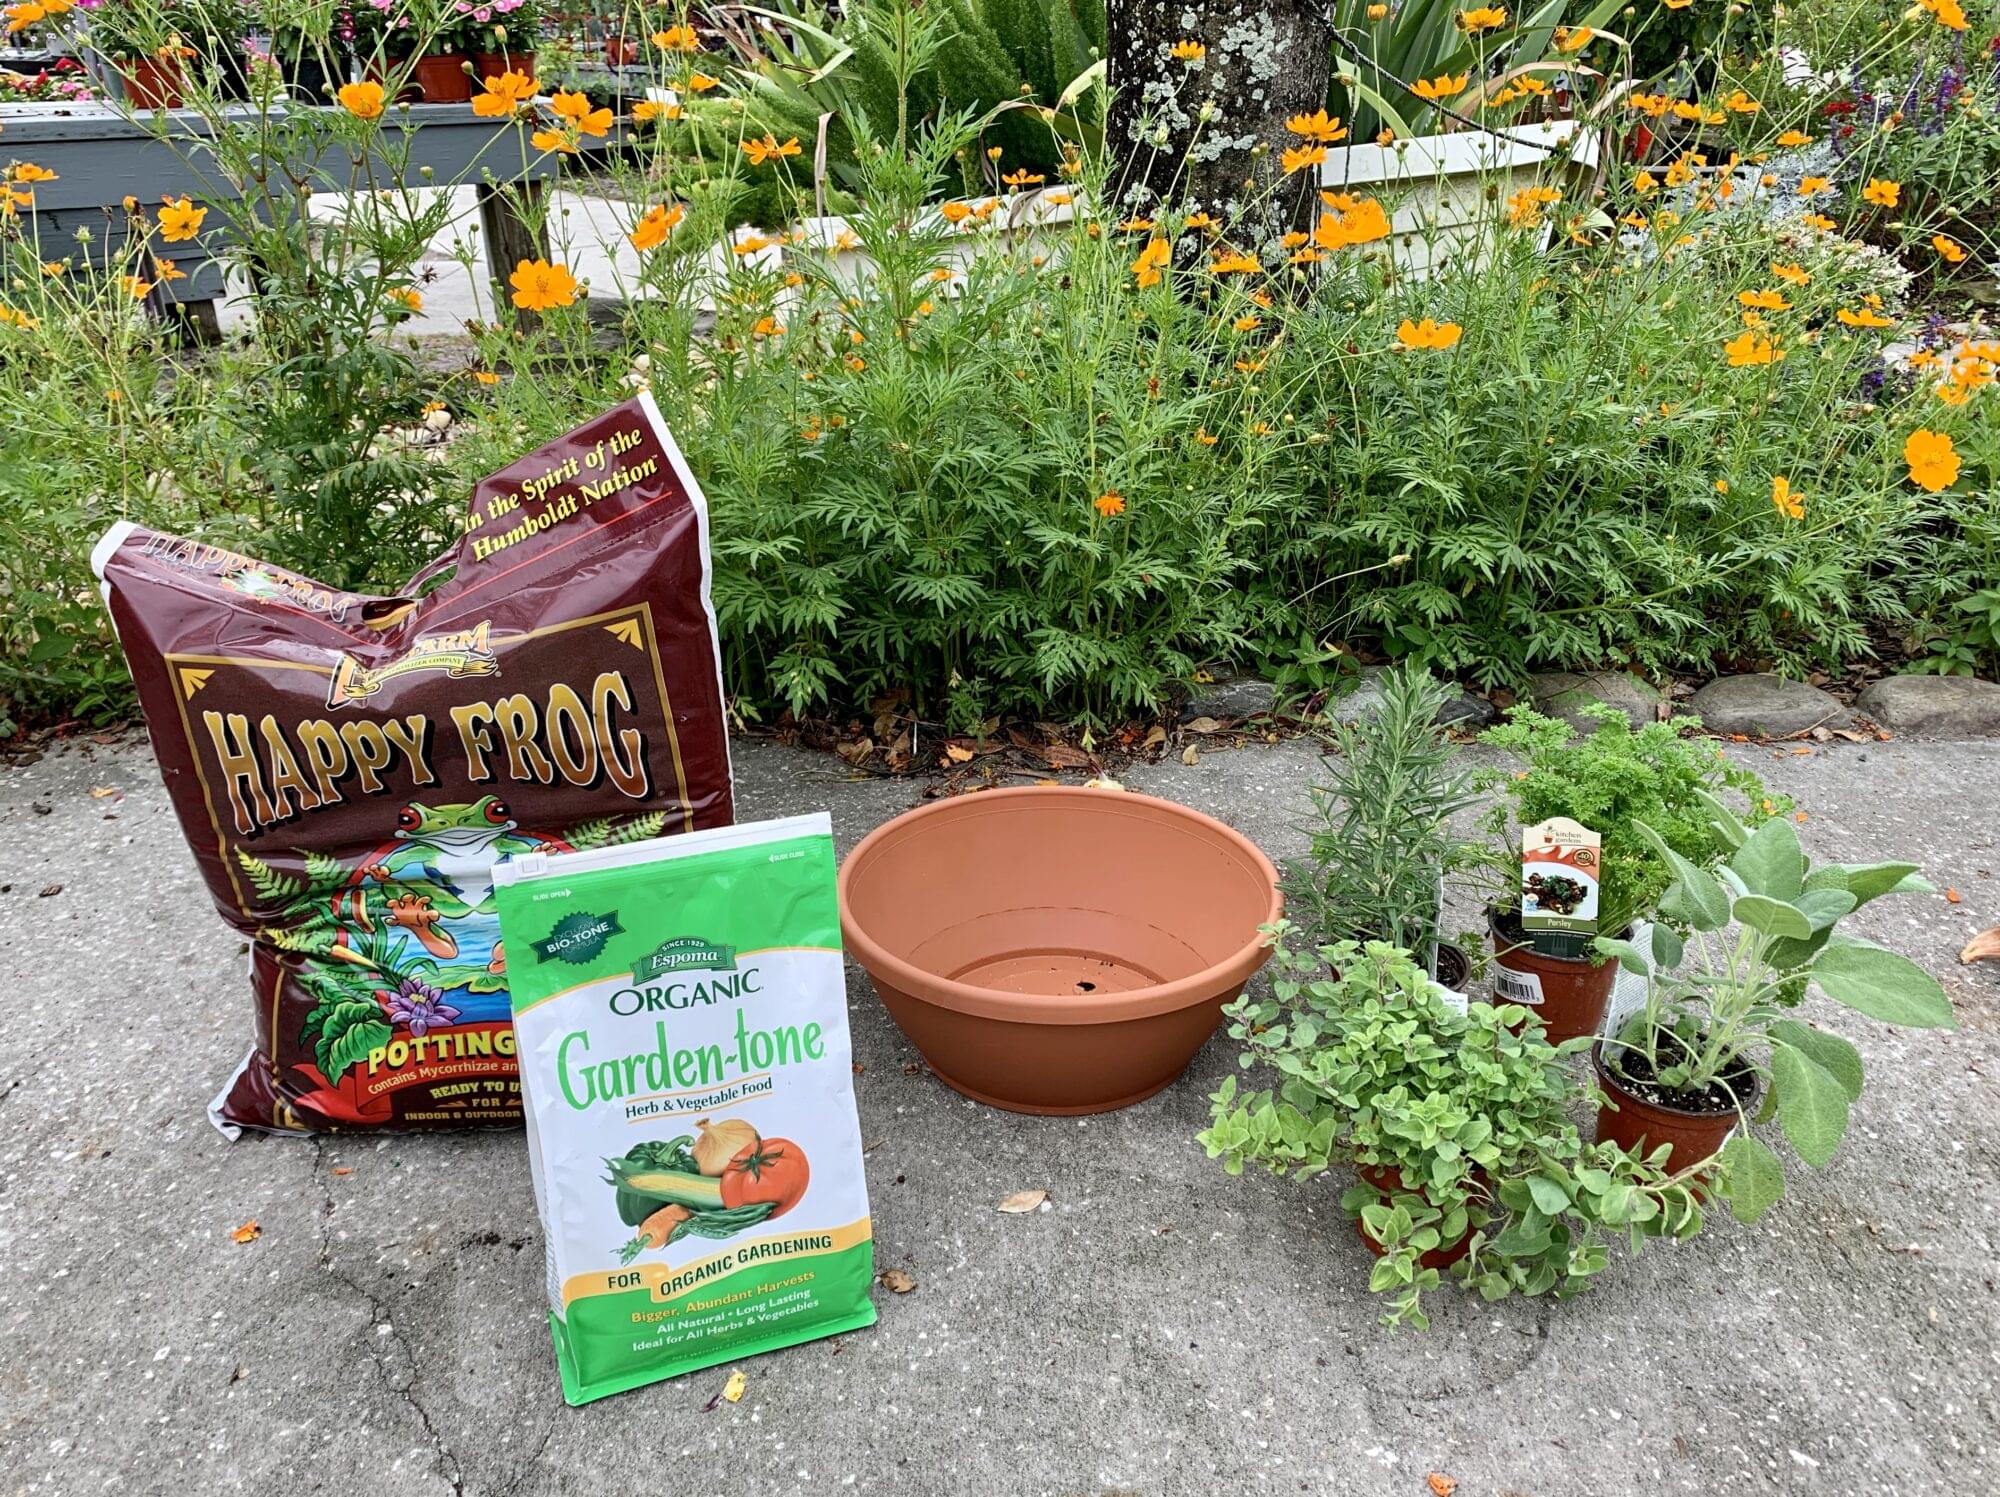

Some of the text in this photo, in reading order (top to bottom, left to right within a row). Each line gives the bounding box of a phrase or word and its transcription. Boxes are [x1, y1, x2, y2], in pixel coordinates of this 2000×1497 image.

[464, 429, 642, 534] In the Spirit of the
[471, 494, 579, 562] Humboldt
[203, 671, 650, 835] HAPPY FROG
[774, 853, 788, 861] SLIDE
[532, 890, 566, 902] SLIDE OPEN
[546, 922, 610, 953] BIO-TONE
[1547, 918, 1572, 929] Parsley
[651, 950, 719, 970] Espoma
[661, 939, 705, 951] SINCE 1929
[609, 968, 761, 1016] ORGANIC
[368, 1030, 516, 1075] POTTING
[557, 1008, 825, 1111] Garden-tone
[368, 1061, 518, 1095] Contains Mycorrhizae an
[430, 1081, 480, 1100] READY
[483, 1081, 505, 1093] TO
[625, 1077, 773, 1119] Herb & Vegetable Food
[405, 1112, 450, 1121] INDOOR
[464, 1110, 521, 1119] OUTDOOR
[472, 1098, 500, 1107] FOR
[608, 1235, 832, 1296] FOR ORGANIC GARDENING
[631, 1271, 816, 1324] Bigger, Abundant Harvests
[656, 1288, 811, 1335] All Natural Long Lasting
[632, 1338, 664, 1352] Ideal
[666, 1333, 684, 1345] for
[685, 1326, 704, 1340] All
[706, 1319, 743, 1336] Herbs
[746, 1316, 756, 1326] &
[757, 1297, 820, 1322] Vegetables
